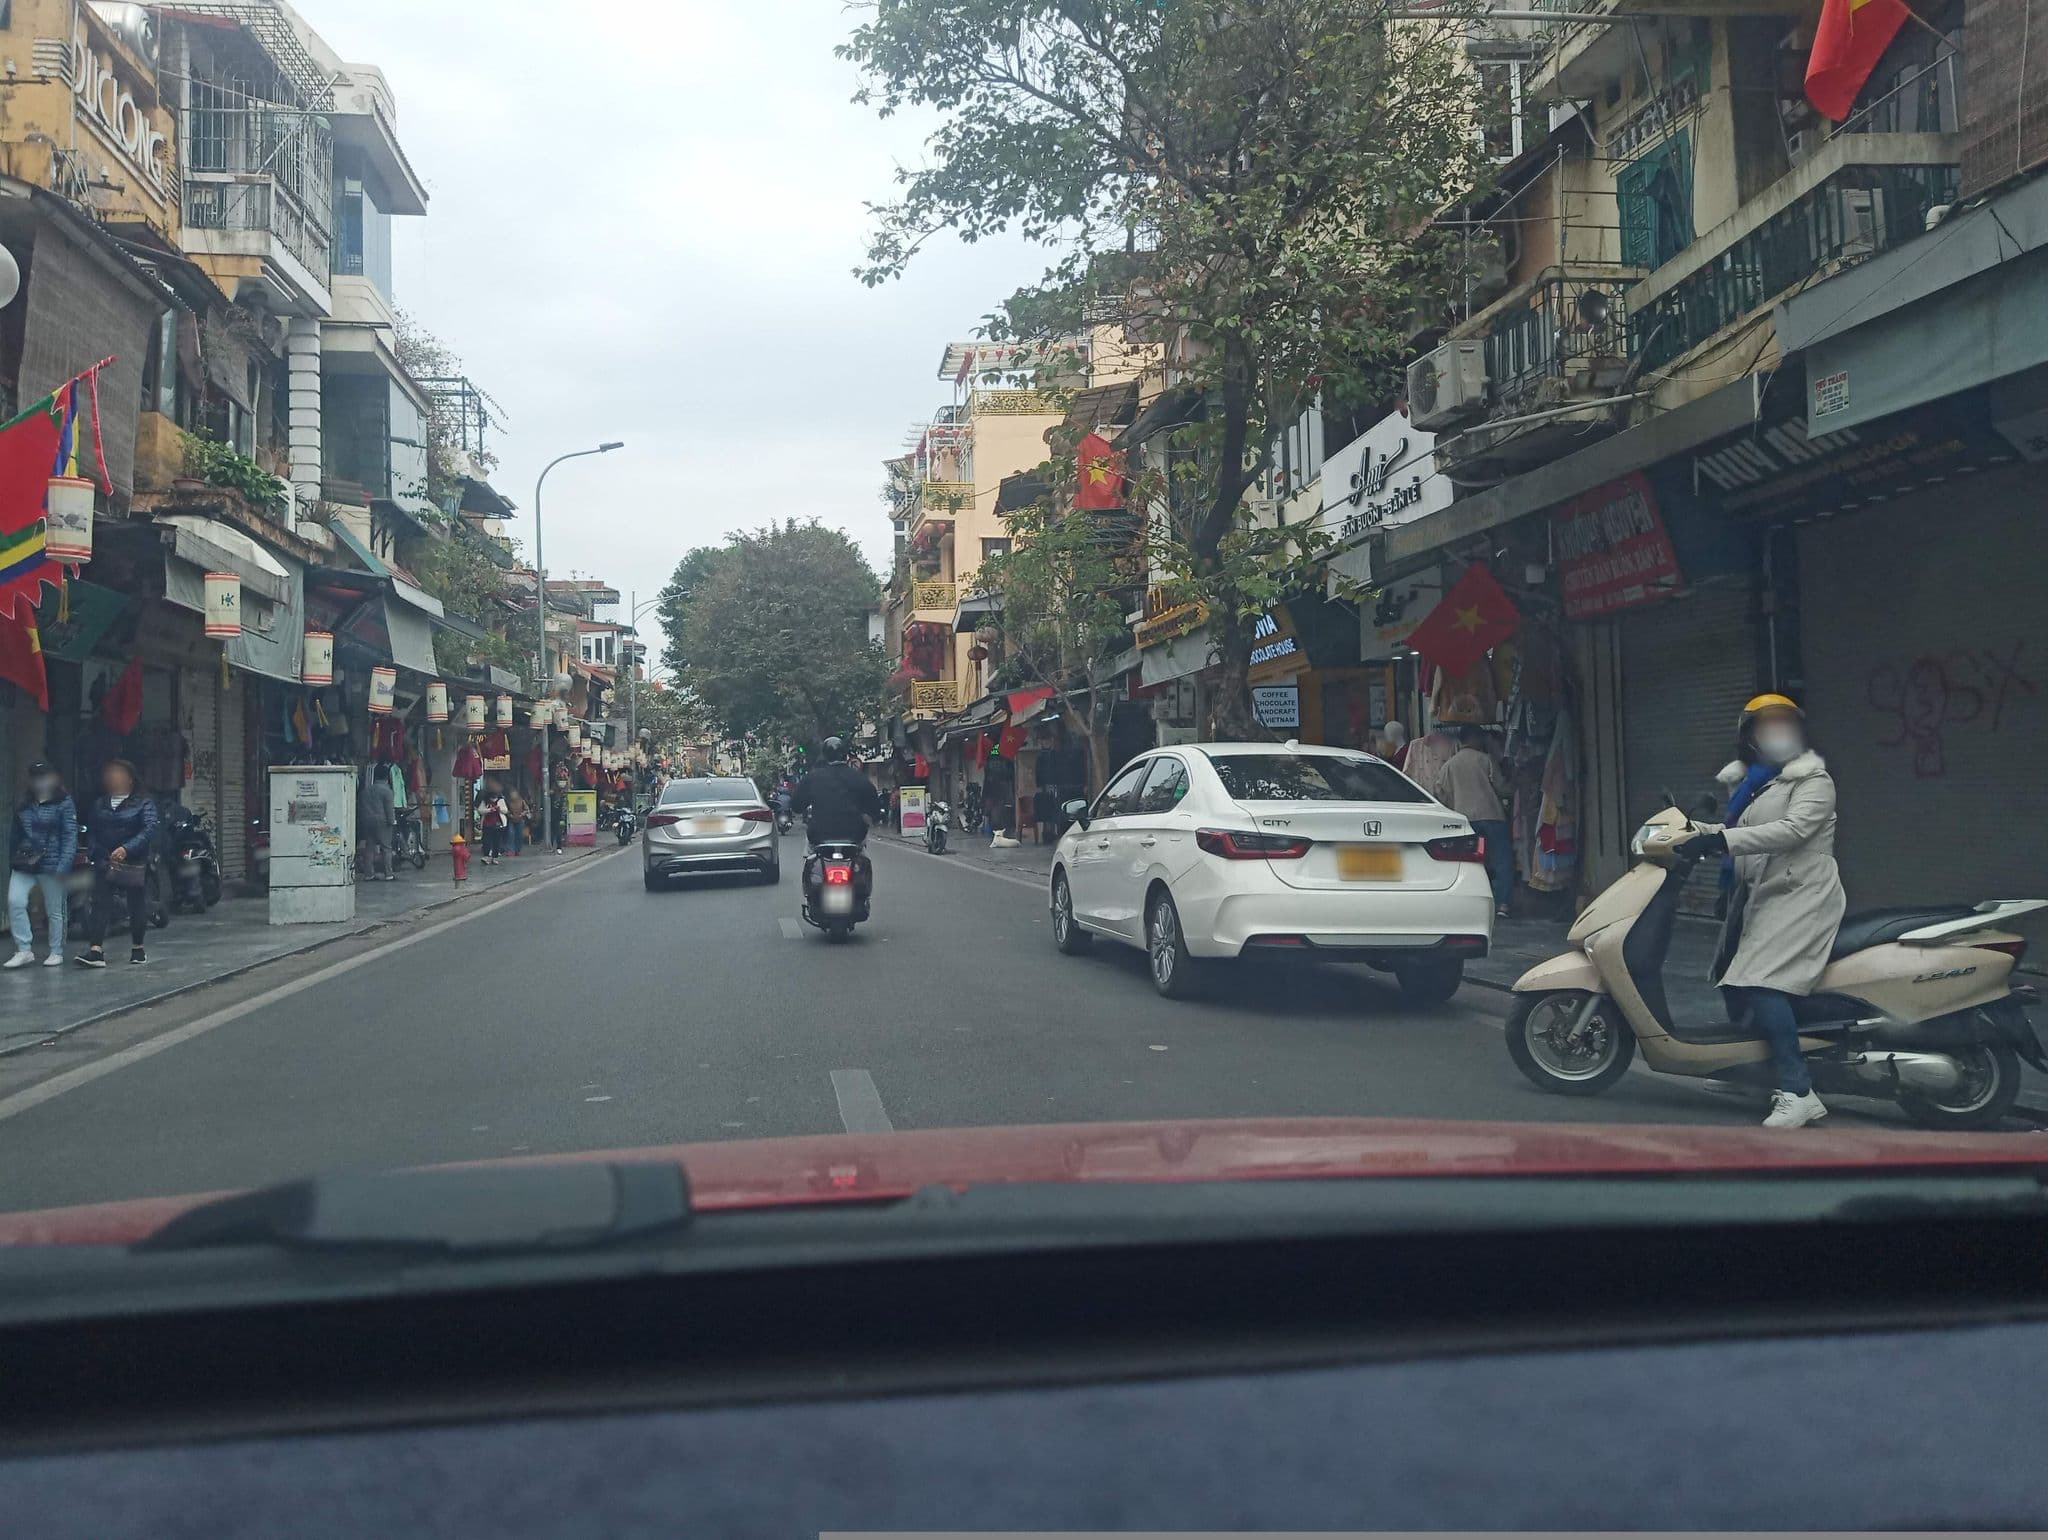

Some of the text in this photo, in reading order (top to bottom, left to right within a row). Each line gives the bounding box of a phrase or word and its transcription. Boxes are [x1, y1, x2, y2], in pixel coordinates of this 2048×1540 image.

[1697, 438, 1781, 490] HUY
[1255, 699, 1296, 707] CHOCOLATE
[1266, 716, 1295, 724] VIETNAM
[1263, 819, 1291, 827] CITY
